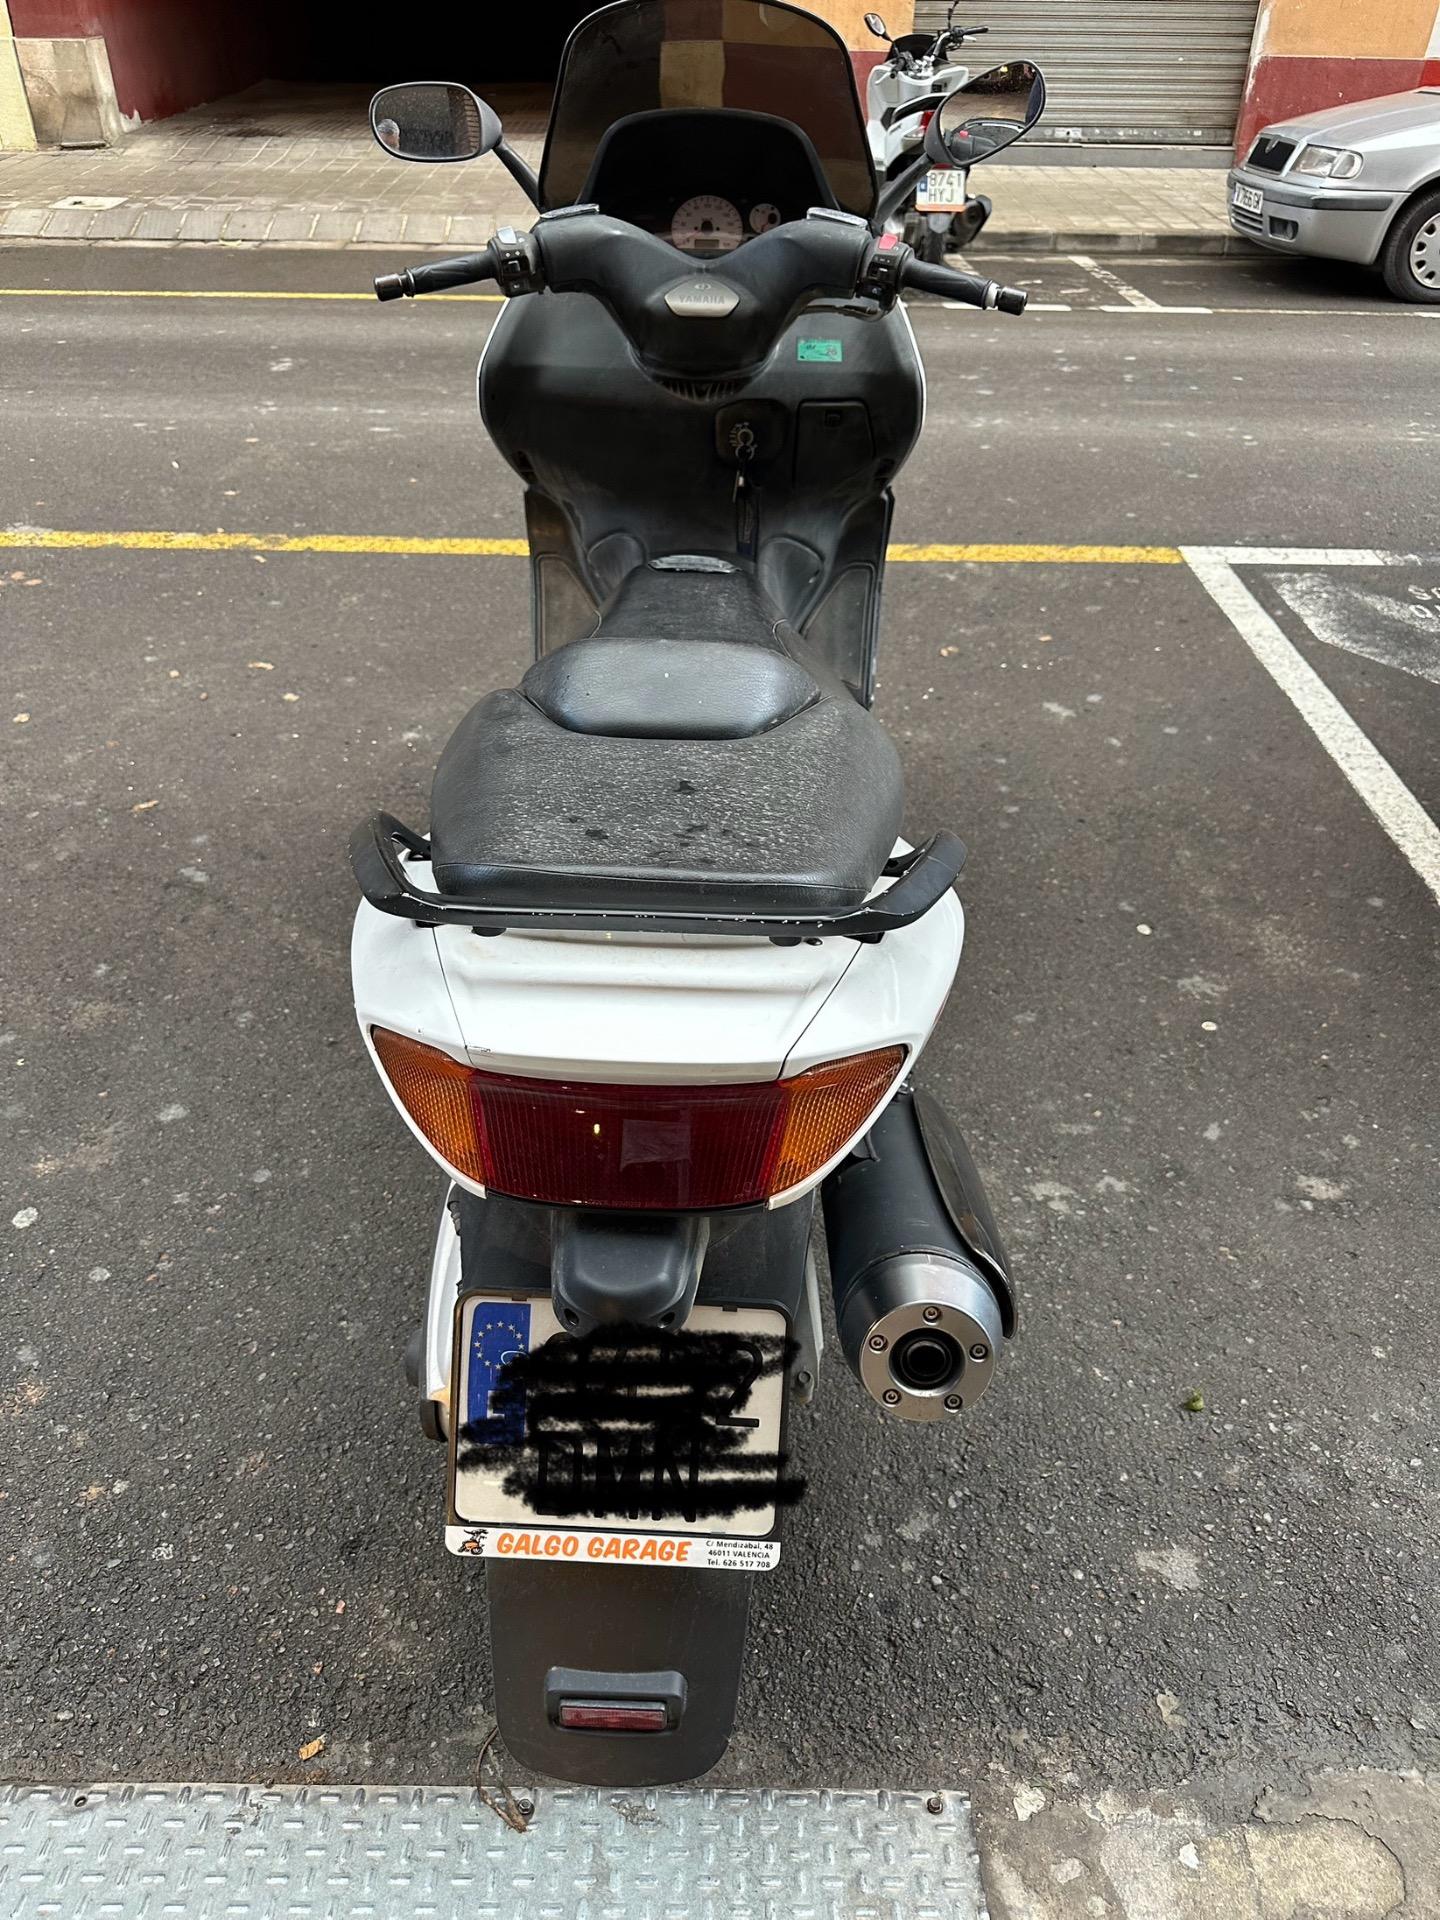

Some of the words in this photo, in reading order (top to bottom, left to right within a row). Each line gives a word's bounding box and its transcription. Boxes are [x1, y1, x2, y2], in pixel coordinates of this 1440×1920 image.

[929, 172, 962, 187] 8741
[929, 188, 955, 203] HYJ
[679, 295, 725, 304] YAMAHA
[497, 1532, 579, 1557] GALGO
[587, 1536, 692, 1562] GARAGE
[723, 1559, 737, 1567] 626
